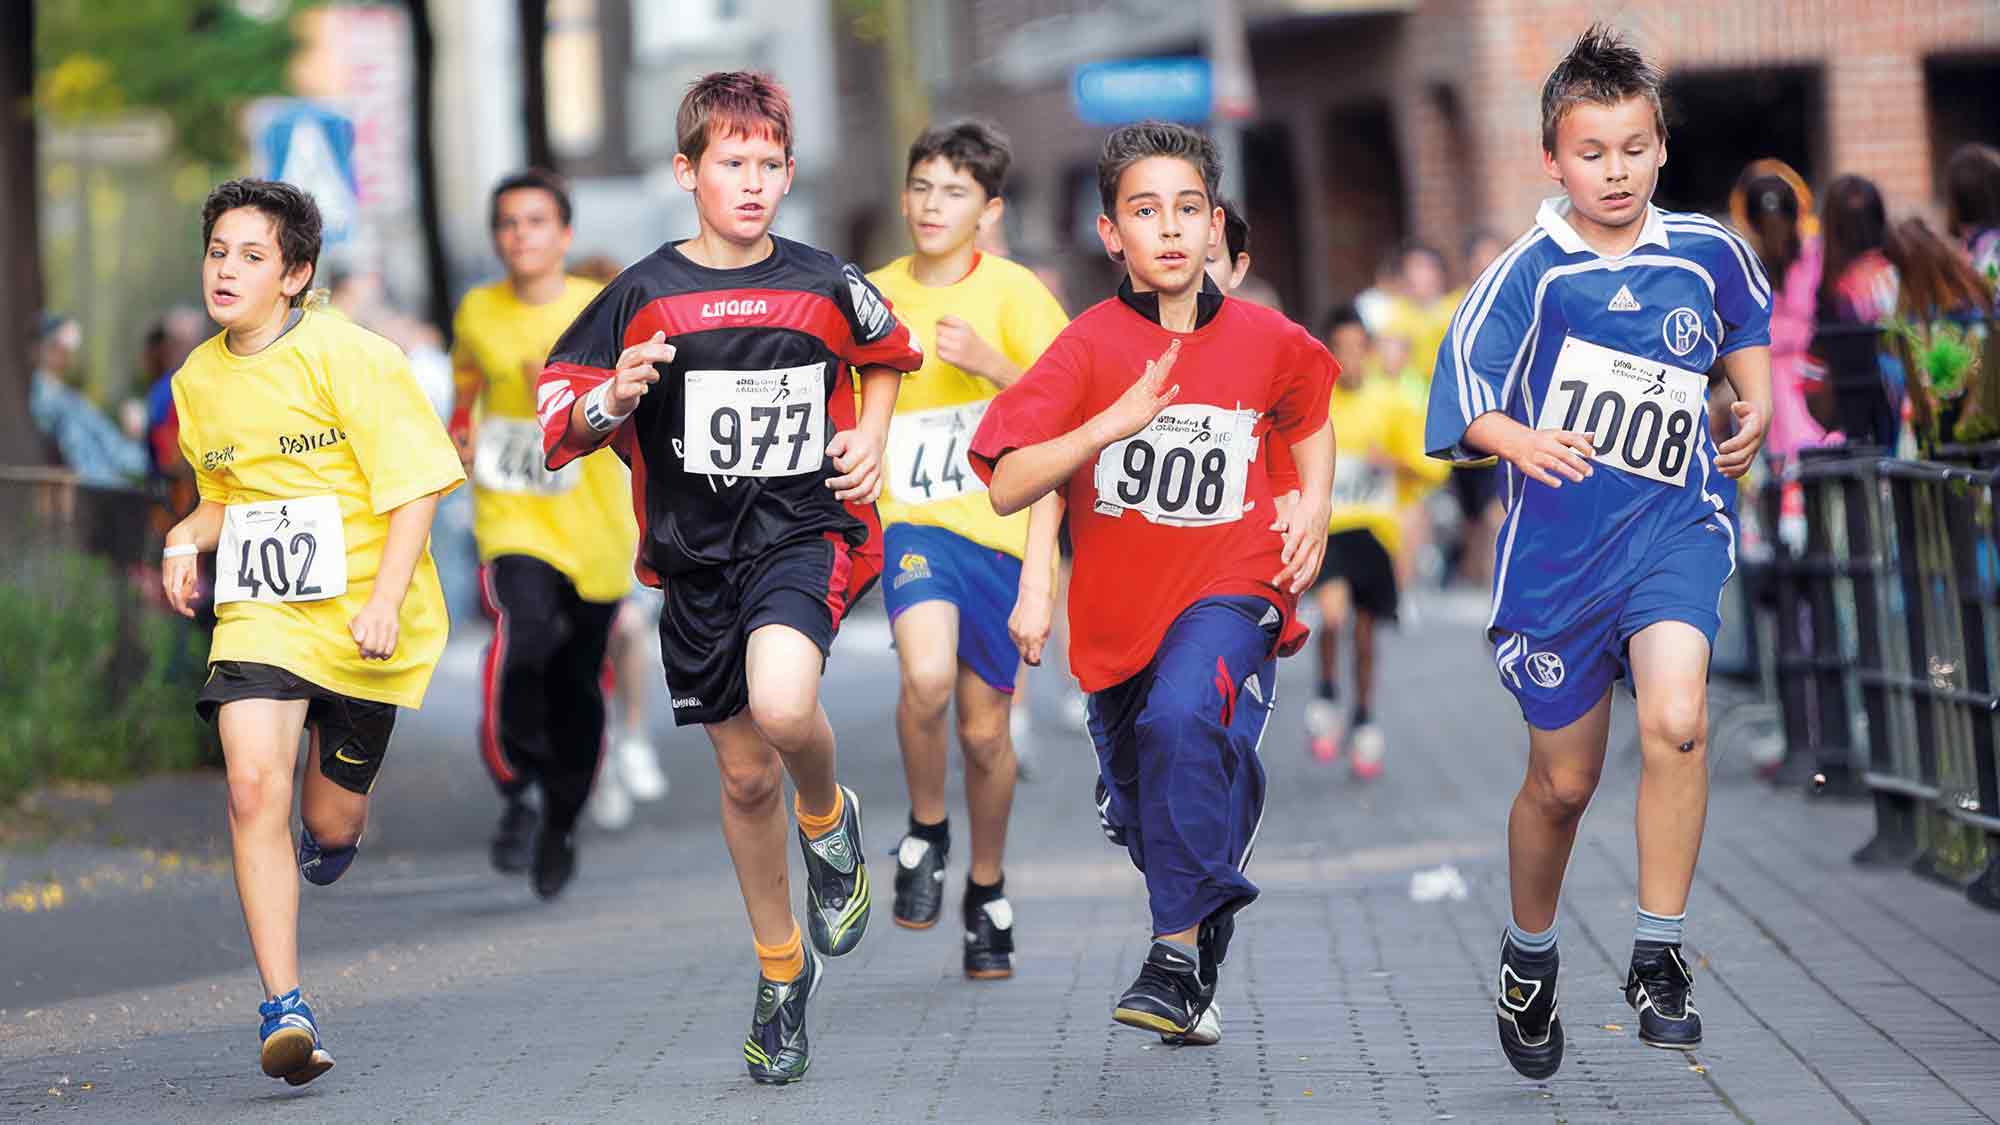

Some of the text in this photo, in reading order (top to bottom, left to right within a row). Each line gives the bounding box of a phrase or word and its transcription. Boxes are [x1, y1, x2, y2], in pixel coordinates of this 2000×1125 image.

[710, 402, 812, 471] 977
[1117, 439, 1227, 515] 908
[238, 532, 323, 598] 402
